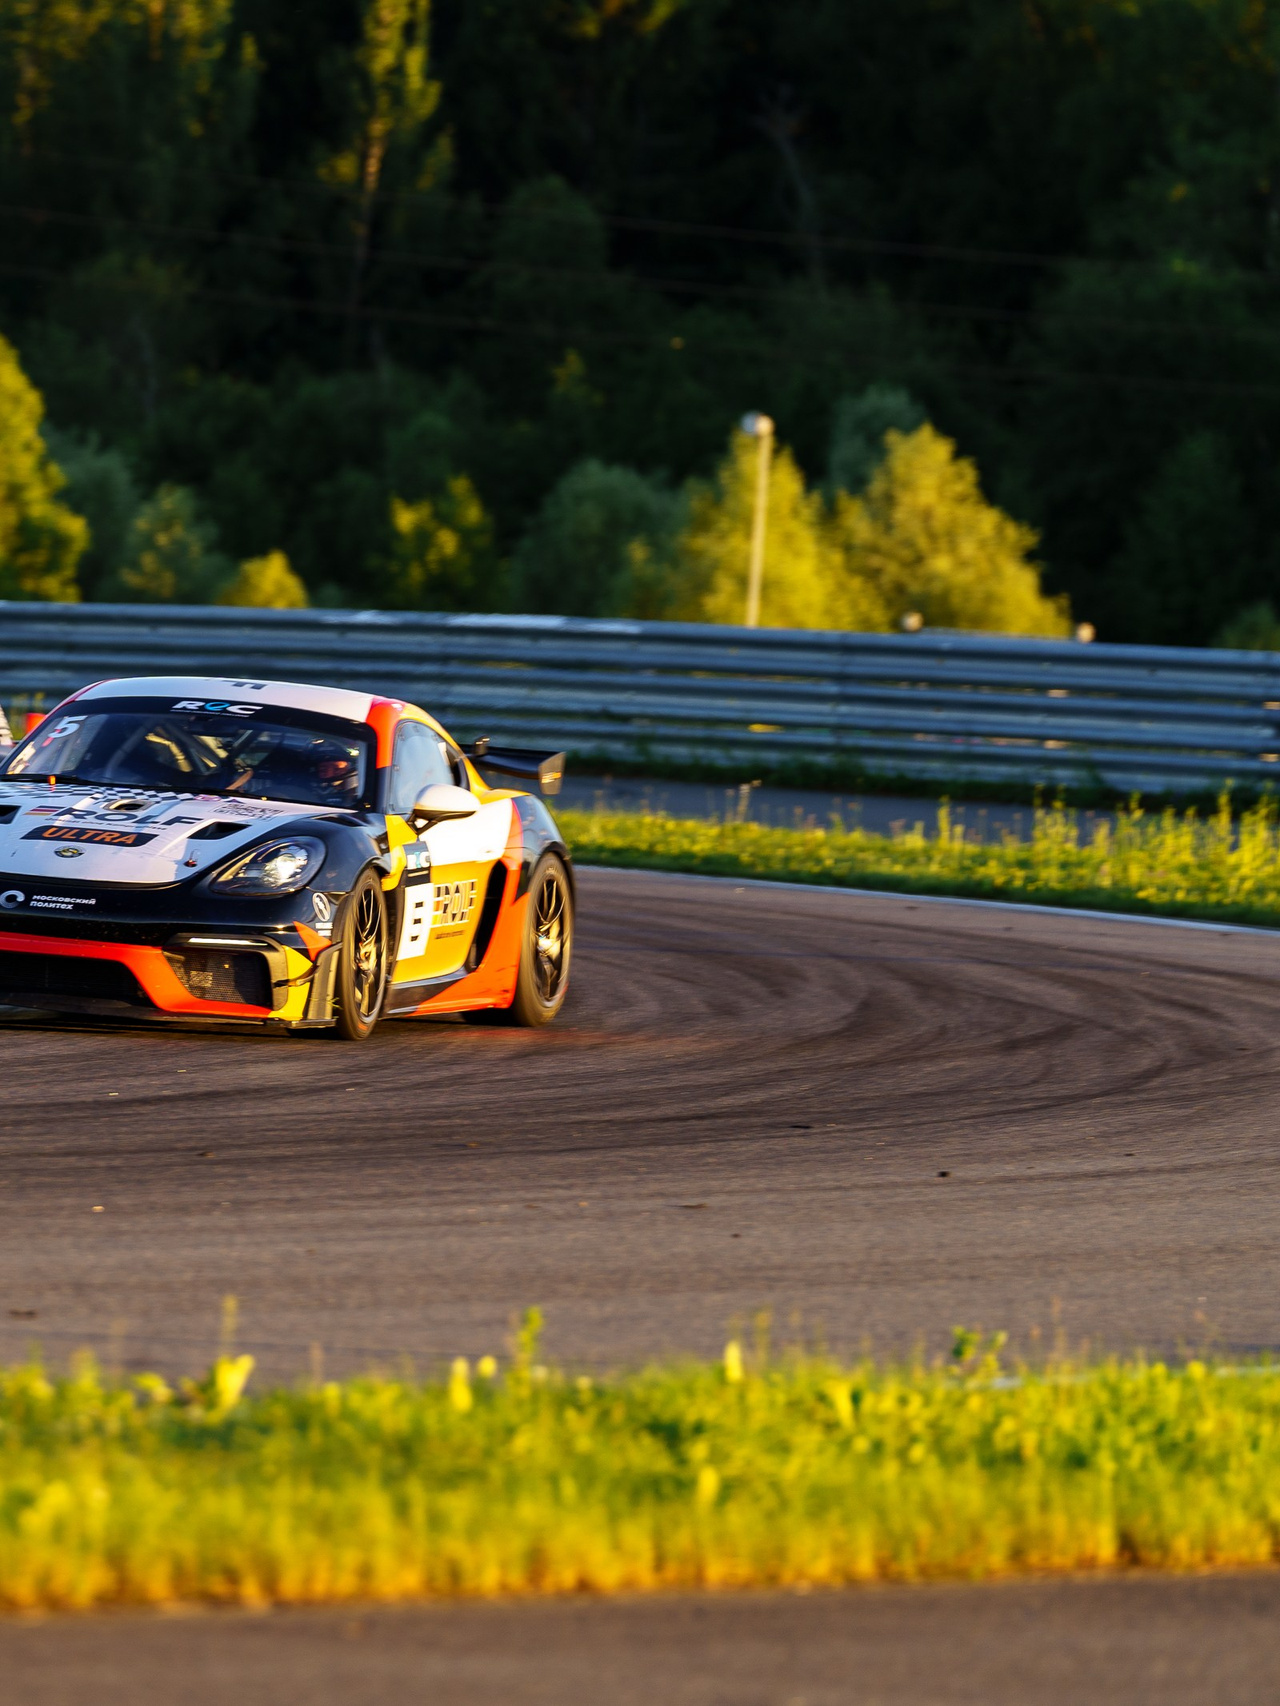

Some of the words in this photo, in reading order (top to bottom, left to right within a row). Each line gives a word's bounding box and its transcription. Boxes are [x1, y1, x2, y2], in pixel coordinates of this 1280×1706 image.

[47, 715, 88, 738] 5
[53, 807, 204, 825] ROLF
[41, 827, 138, 844] ULTRA
